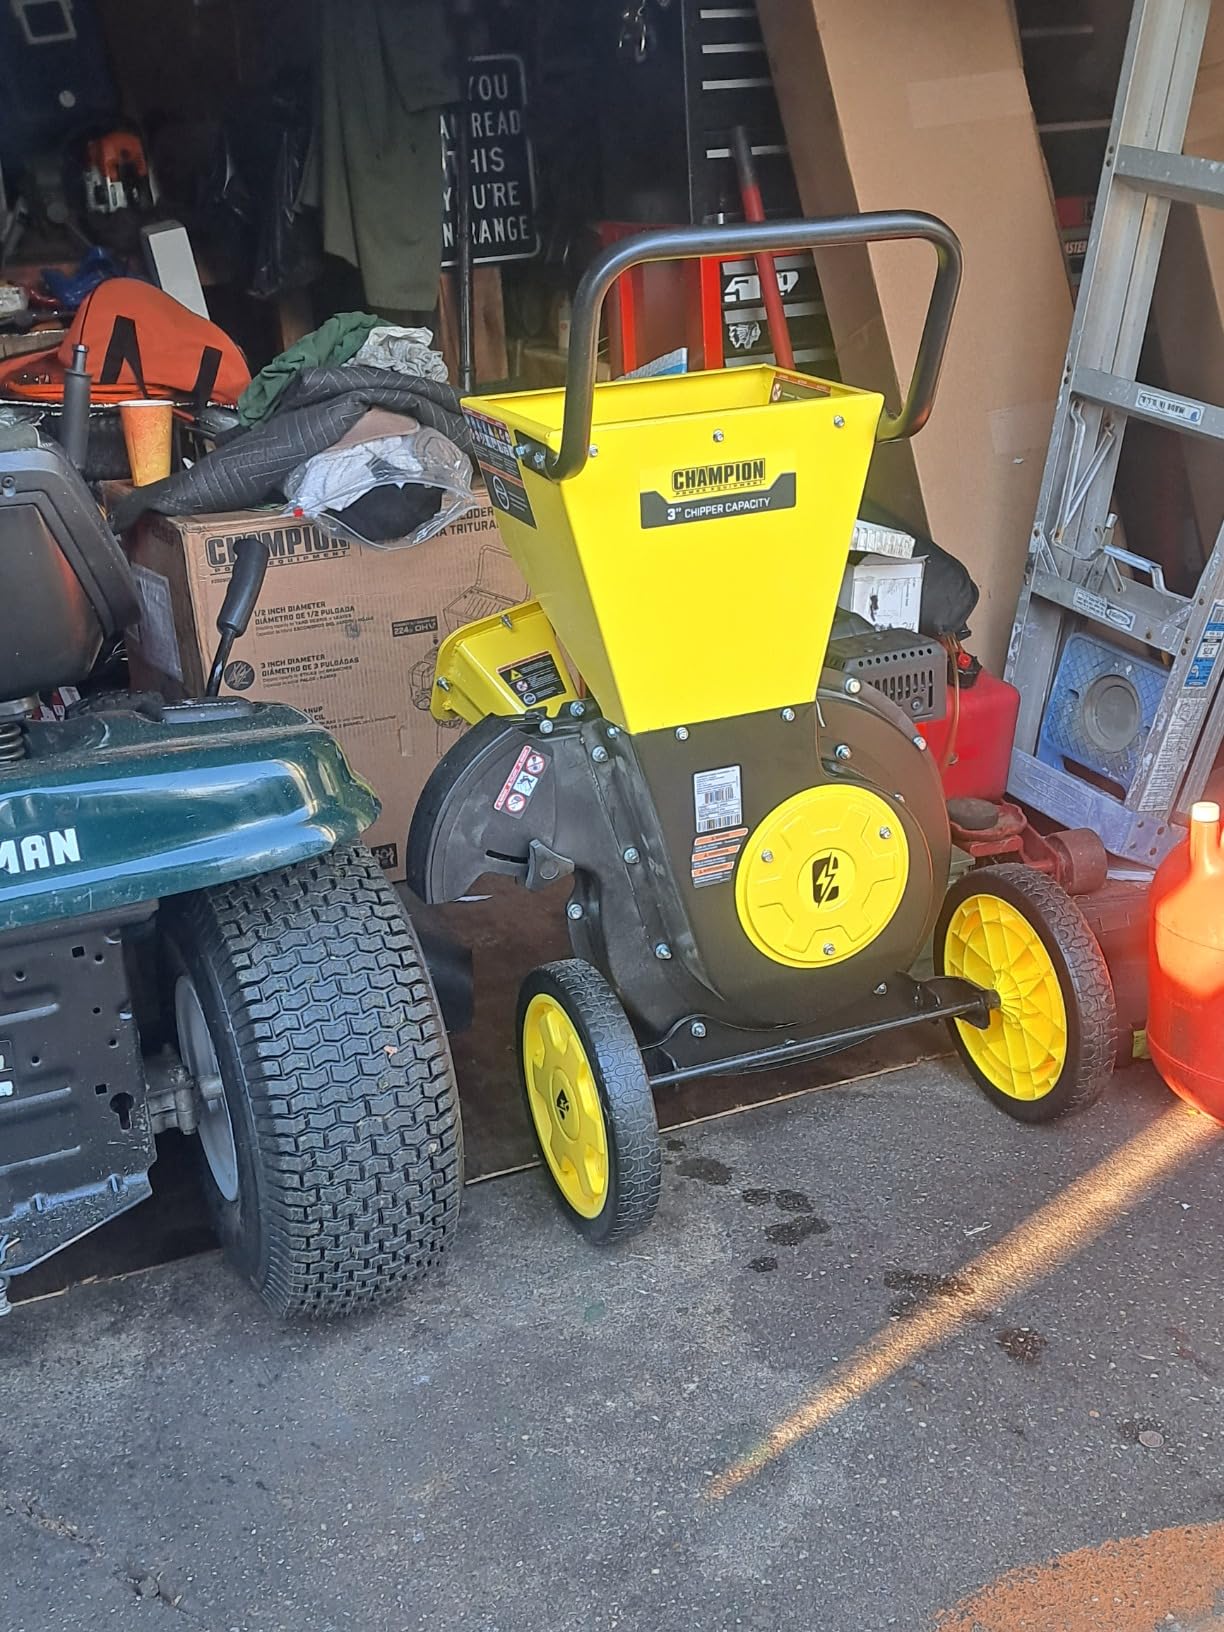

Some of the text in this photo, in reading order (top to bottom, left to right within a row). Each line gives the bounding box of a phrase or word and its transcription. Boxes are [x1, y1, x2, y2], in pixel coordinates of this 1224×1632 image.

[471, 110, 520, 138] READ
[443, 182, 520, 211] YU'RE
[674, 460, 764, 490] CHAMPION
[667, 497, 771, 521] 3" CHIPPER CAPACITY
[450, 520, 498, 535] TRITURA
[254, 601, 326, 617] 1/2 INCH DIAMETER
[320, 605, 355, 617] PULGADA
[415, 622, 436, 632] OHV
[267, 659, 286, 668] INCH
[287, 653, 325, 665] DIAMETER
